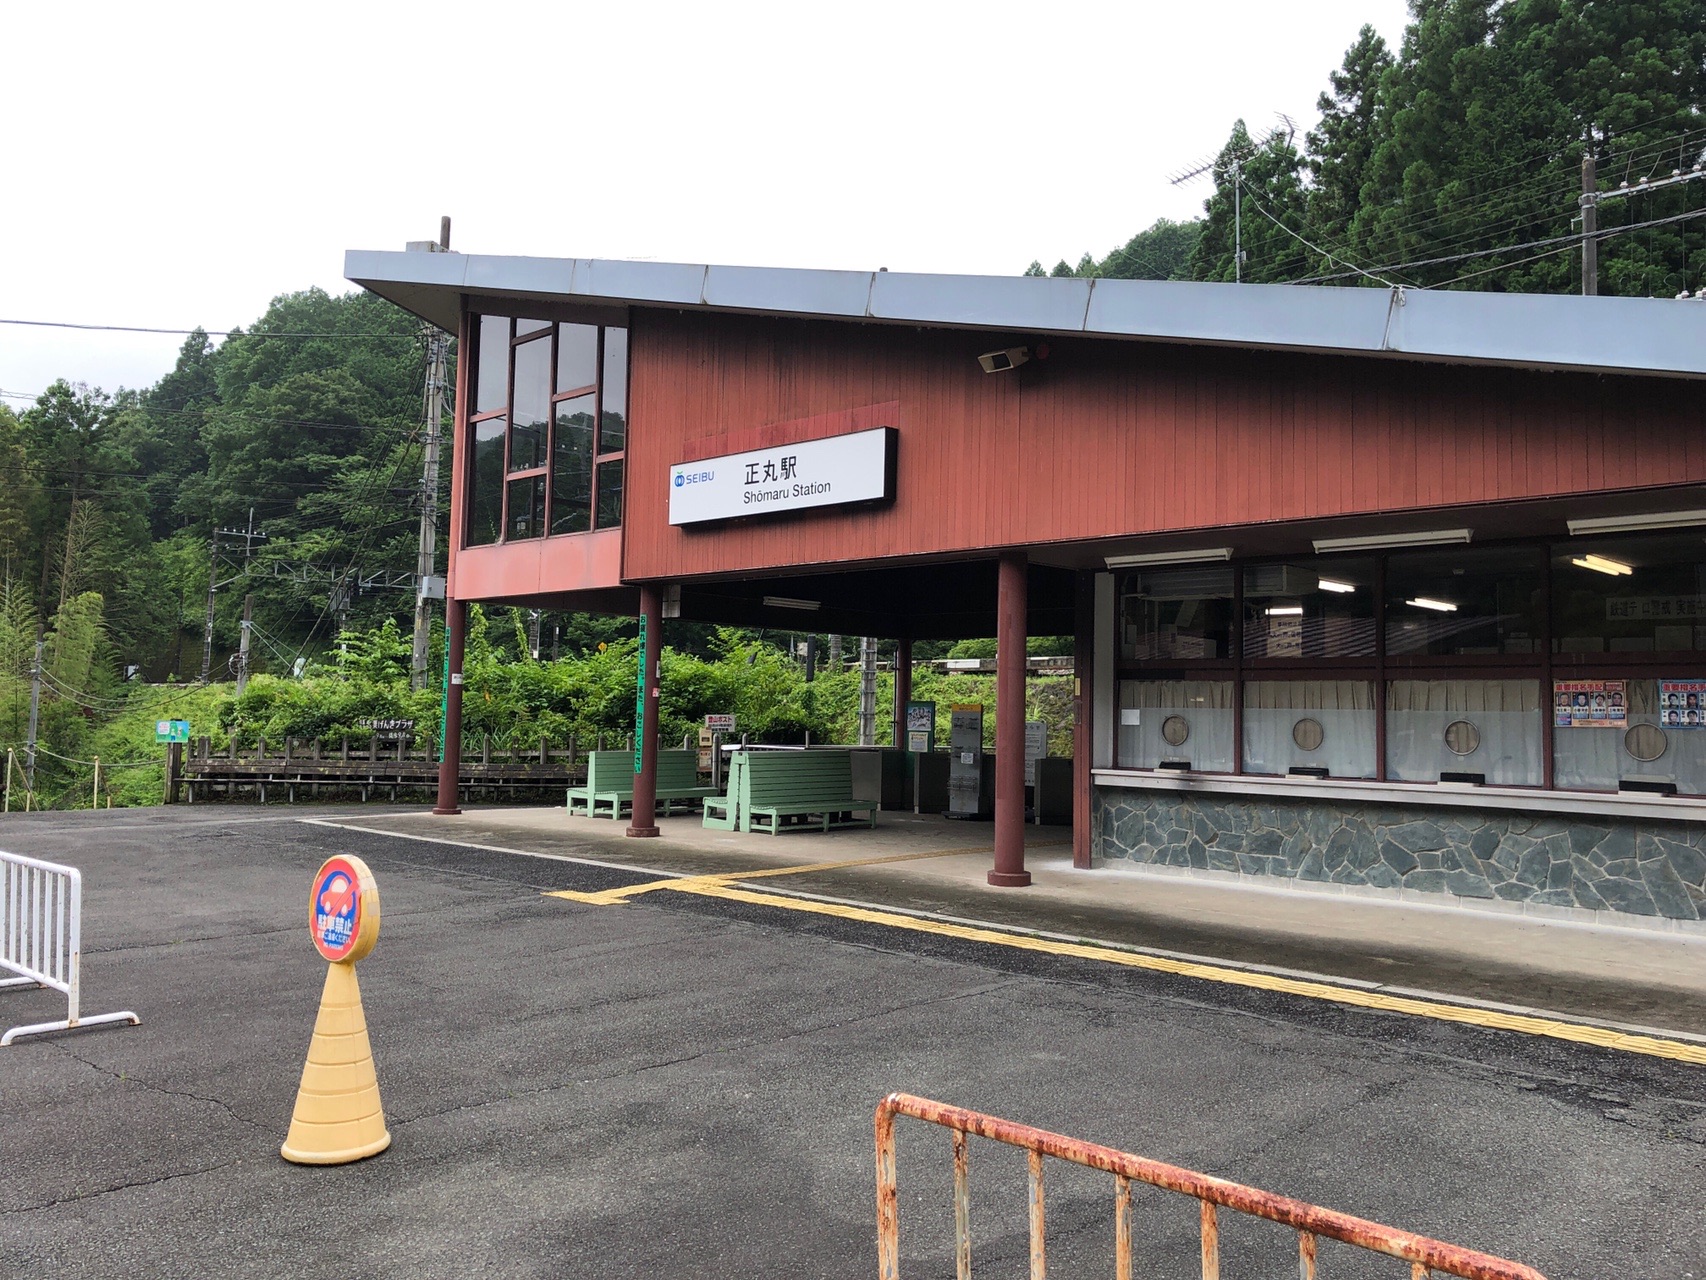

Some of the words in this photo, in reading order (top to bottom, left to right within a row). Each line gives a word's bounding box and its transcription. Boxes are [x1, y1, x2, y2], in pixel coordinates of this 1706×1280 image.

[685, 470, 715, 485] SEIBU
[744, 455, 797, 485] 正丸駅
[743, 488, 789, 504] Shōmaru
[792, 481, 831, 497] Station
[1555, 683, 1603, 691] 重要指名手配
[317, 913, 353, 935] 駐車禁止
